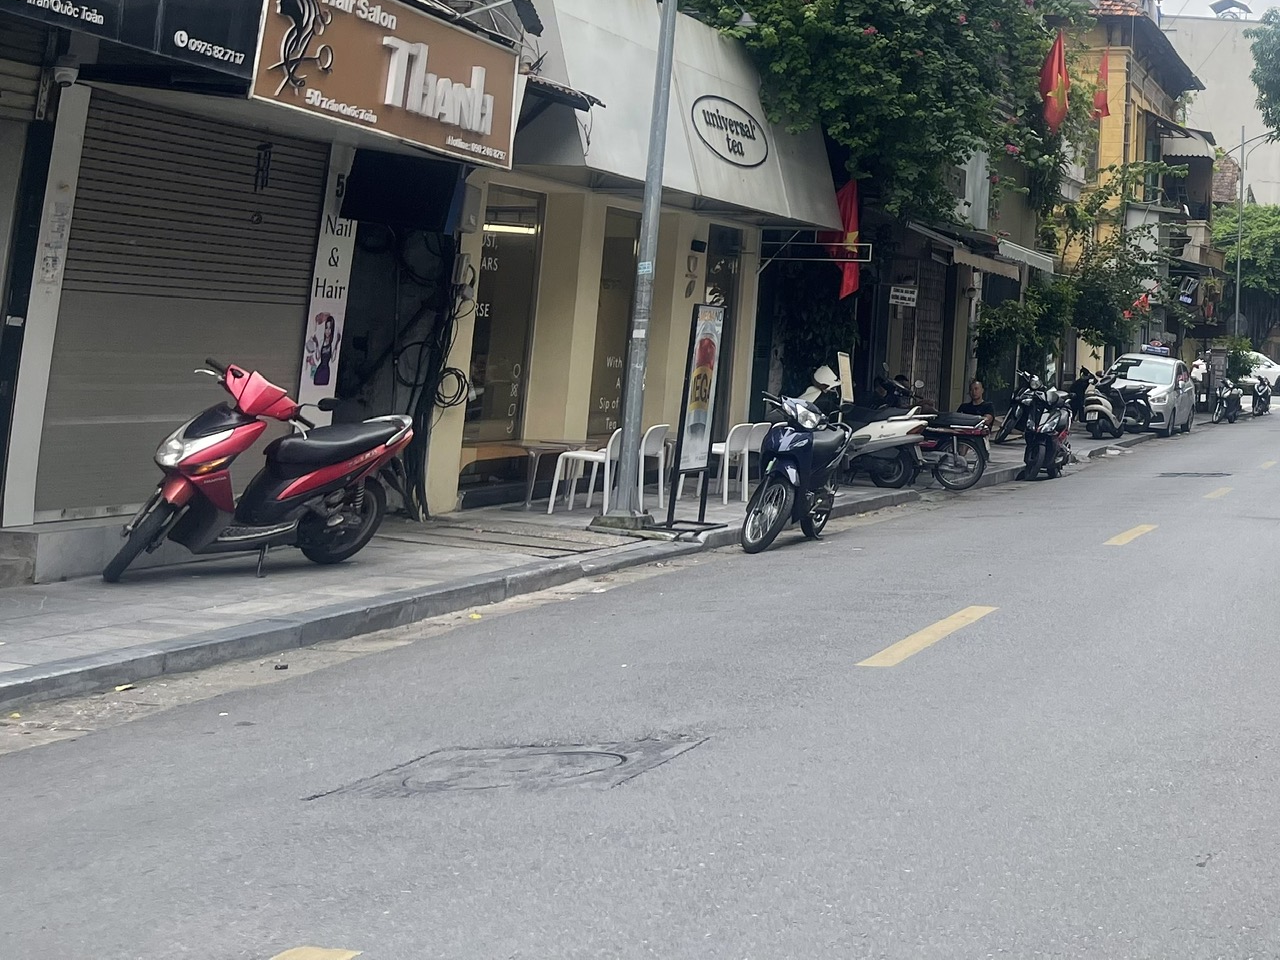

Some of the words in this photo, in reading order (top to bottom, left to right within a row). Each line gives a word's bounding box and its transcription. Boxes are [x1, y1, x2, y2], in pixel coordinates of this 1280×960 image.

[305, 88, 322, 106] 50
[702, 108, 756, 141] universal
[725, 133, 745, 157] tea
[325, 214, 352, 238] Nail
[328, 246, 339, 267] &
[481, 257, 498, 271] ARS
[314, 277, 345, 300] Hair
[606, 356, 623, 369] With
[615, 377, 621, 389] A
[599, 397, 610, 411] Sip
[611, 397, 620, 409] of
[605, 417, 617, 430] Tea
